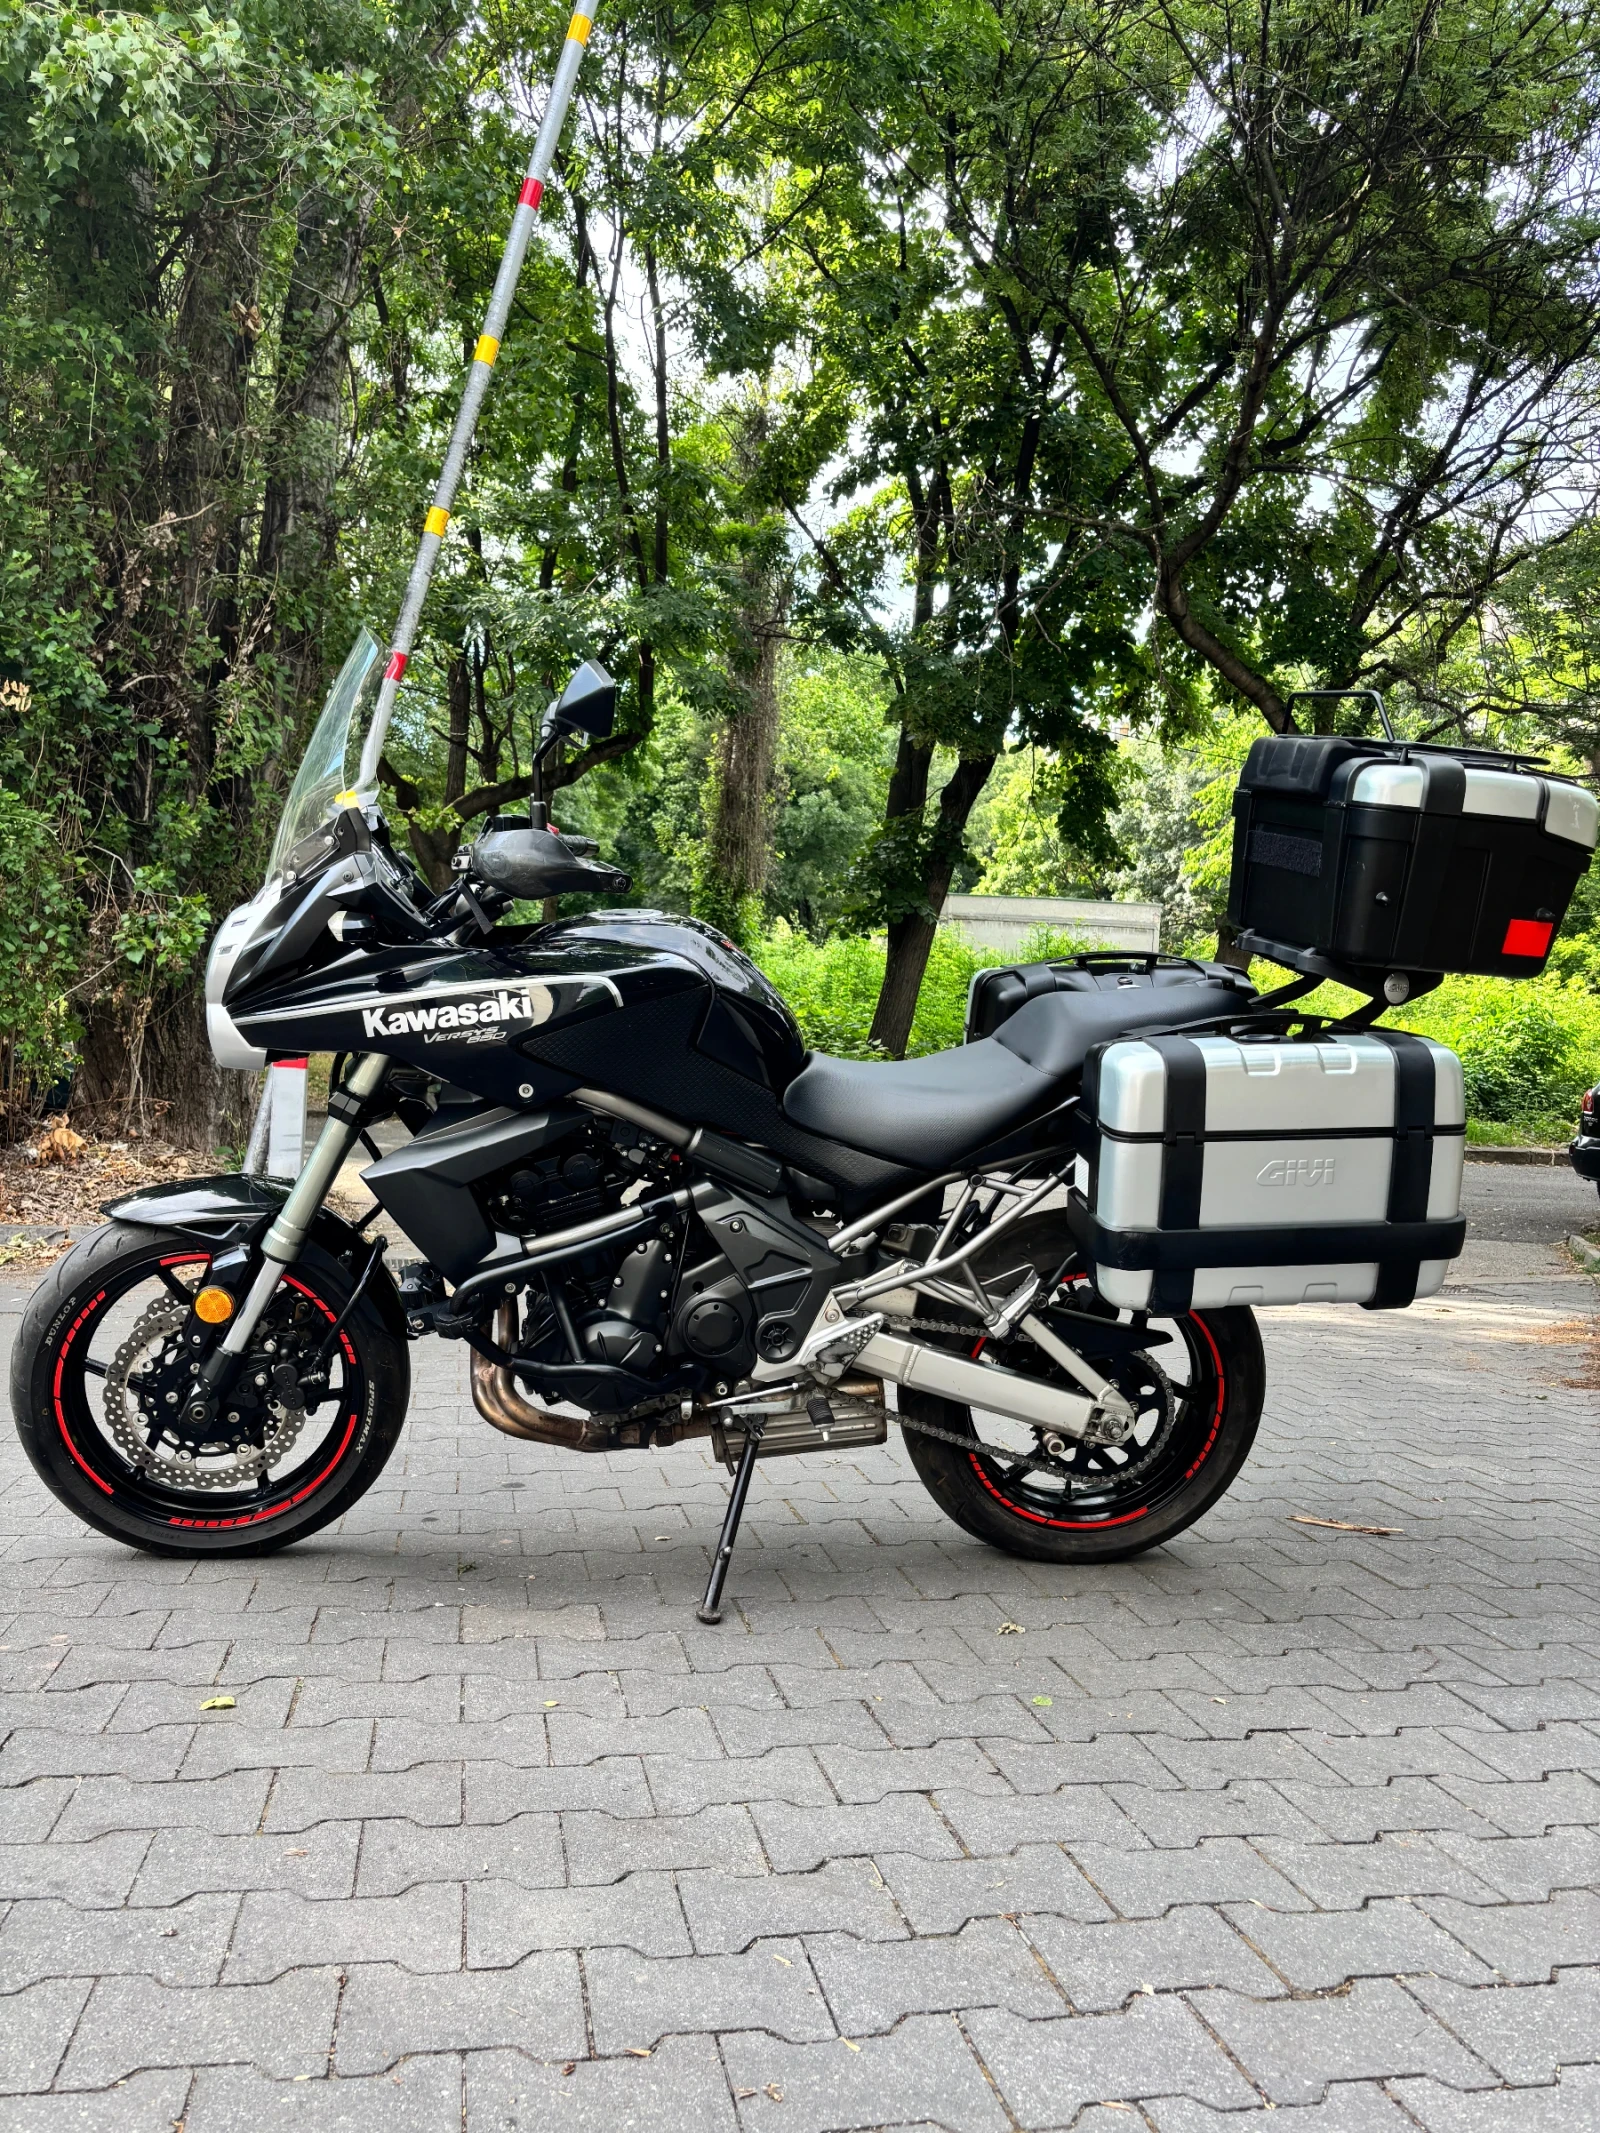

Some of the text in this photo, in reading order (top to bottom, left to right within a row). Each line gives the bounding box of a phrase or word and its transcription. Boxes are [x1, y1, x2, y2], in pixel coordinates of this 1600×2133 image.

[362, 988, 533, 1038] Kawasaki
[466, 1031, 508, 1044] 650
[1256, 1158, 1335, 1187] GIVI
[44, 1296, 77, 1346] DUNLOP
[355, 1379, 375, 1454] SPORTMAX
